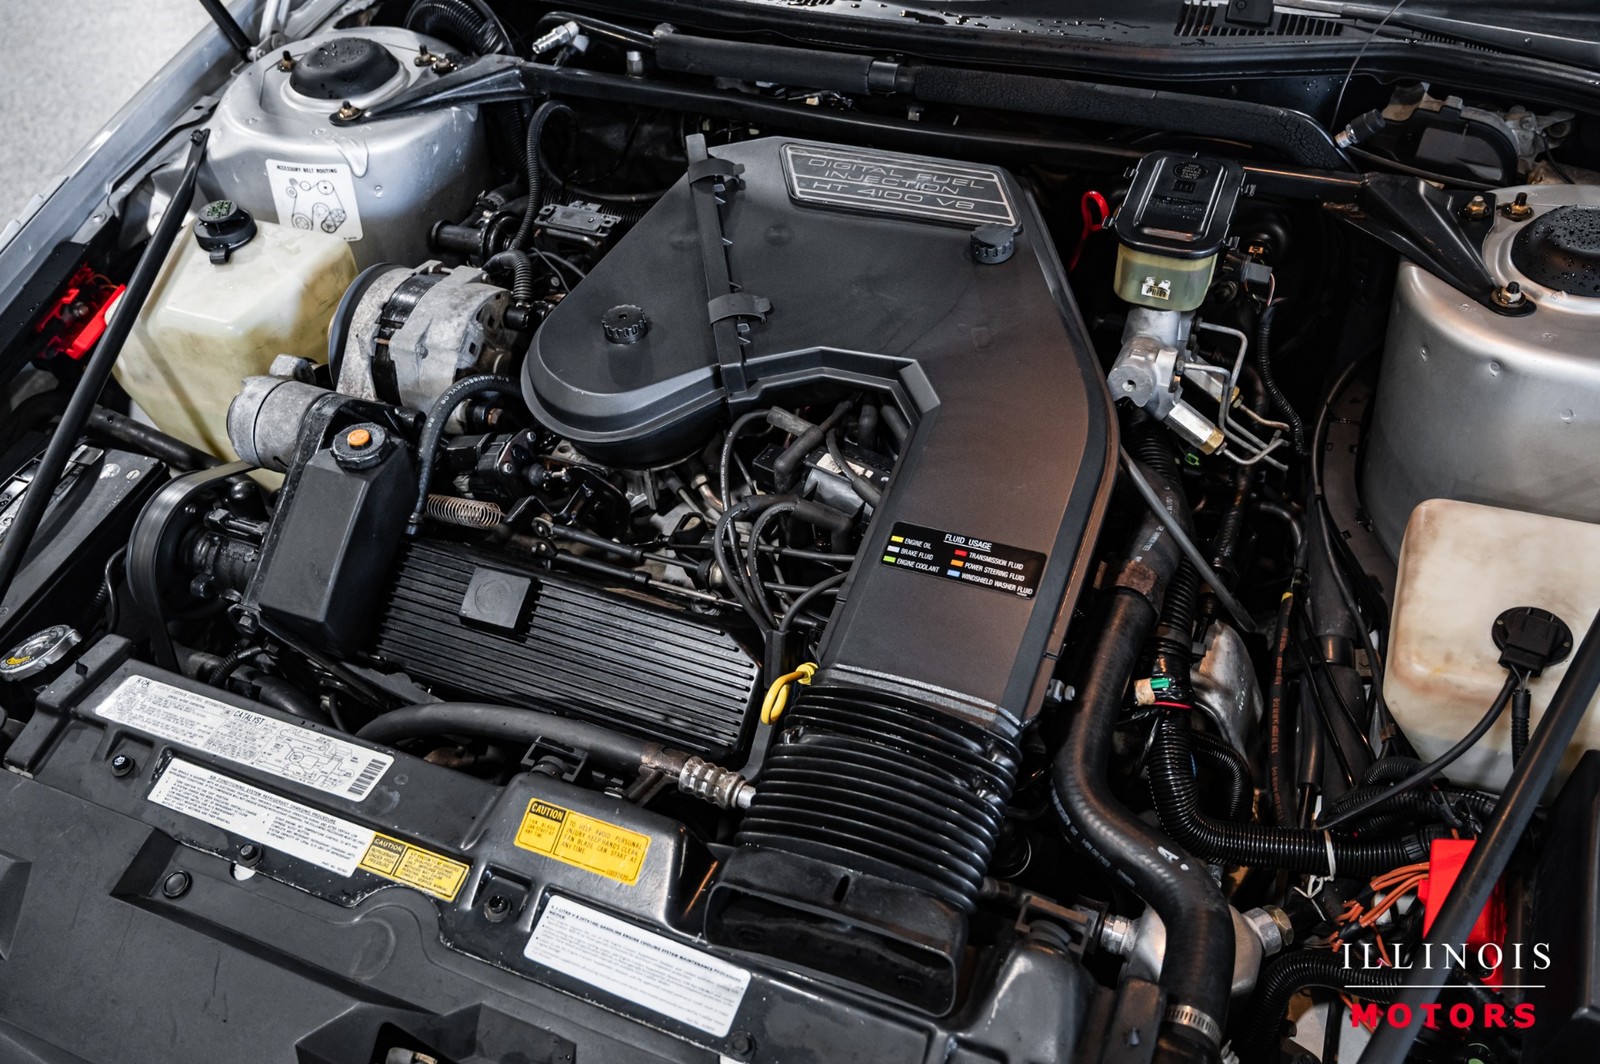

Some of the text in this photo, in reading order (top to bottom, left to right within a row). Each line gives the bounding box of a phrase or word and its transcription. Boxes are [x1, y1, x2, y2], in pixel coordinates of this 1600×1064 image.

[808, 158, 985, 190] DIGITAL FUEL
[825, 170, 960, 195] INJECTION
[813, 181, 975, 210] HT 4100 V8
[904, 538, 922, 546] ENGINE
[944, 534, 992, 549] FLUID USAGE
[900, 548, 933, 560] BRAKE FLUID
[968, 552, 1023, 569] TRANSMISSION FLUID
[896, 558, 939, 572] ENGINE COOLANT
[964, 562, 1025, 581] POWER STEERING FLUID
[961, 573, 1033, 594] WINDSHIELD WASHER FLUID
[233, 710, 265, 724] CATALYST
[531, 803, 563, 820] CAUTION
[541, 822, 555, 830] BLADE
[374, 837, 402, 852] CAUTION
[566, 827, 585, 838] INJURY
[587, 834, 600, 843] KEEP
[601, 839, 620, 849] HANDS
[579, 823, 591, 832] HELP
[595, 829, 610, 838] AVOID
[614, 835, 641, 849] PERSONAL
[370, 847, 396, 860] REFRIGERANT
[563, 834, 574, 842] FAN
[577, 838, 593, 848] BLADE
[596, 845, 607, 853] CAN
[610, 849, 626, 859] START
[368, 857, 389, 868] PRESSURE
